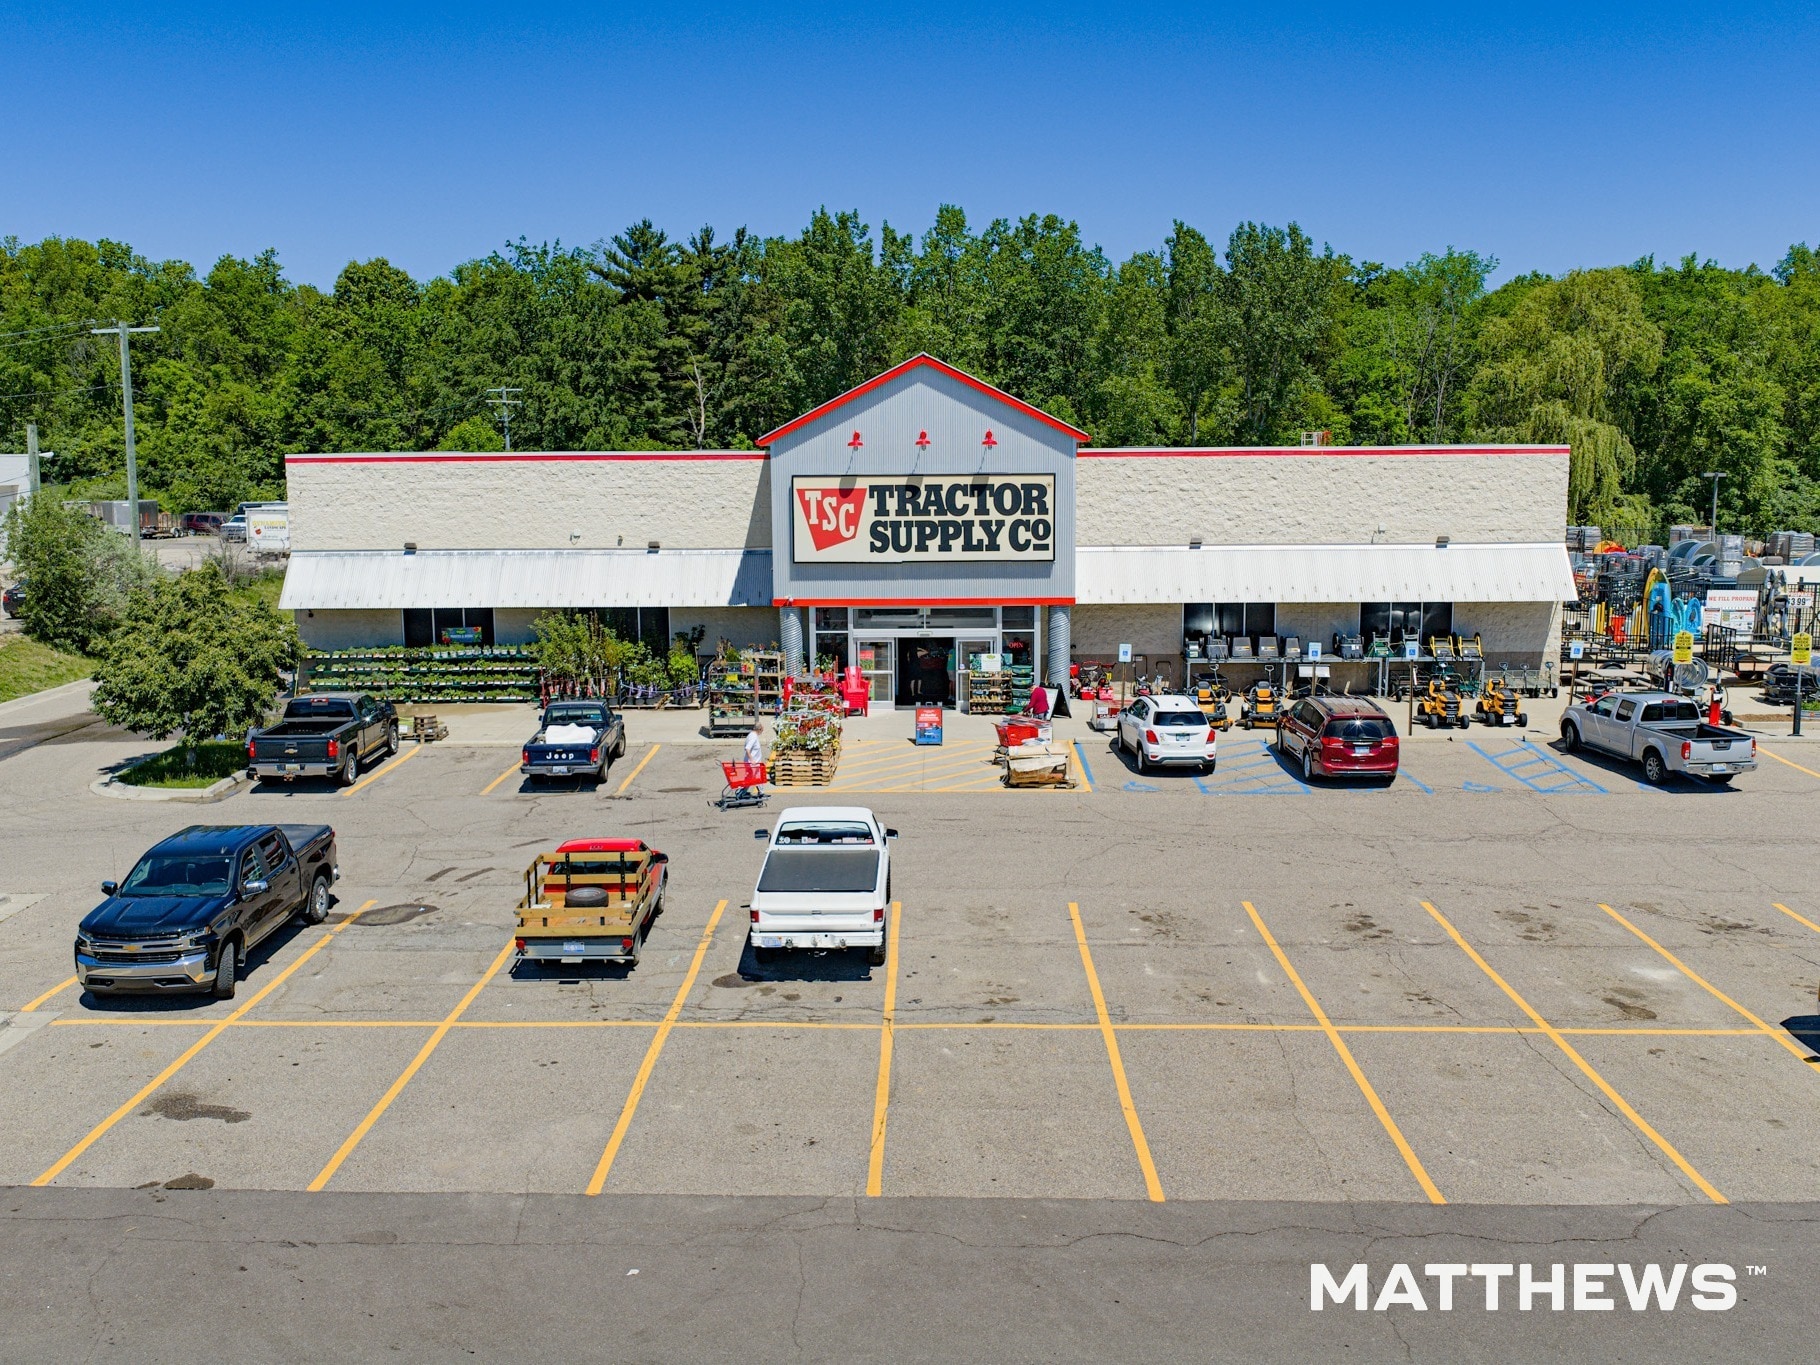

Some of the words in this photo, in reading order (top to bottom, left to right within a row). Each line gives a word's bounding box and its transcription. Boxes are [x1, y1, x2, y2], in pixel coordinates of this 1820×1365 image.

[804, 490, 855, 539] TSC
[869, 483, 1049, 517] TRACTOR
[869, 519, 1006, 553] SUPPLY
[1009, 641, 1024, 649] OPEN
[546, 752, 574, 760] Jeep
